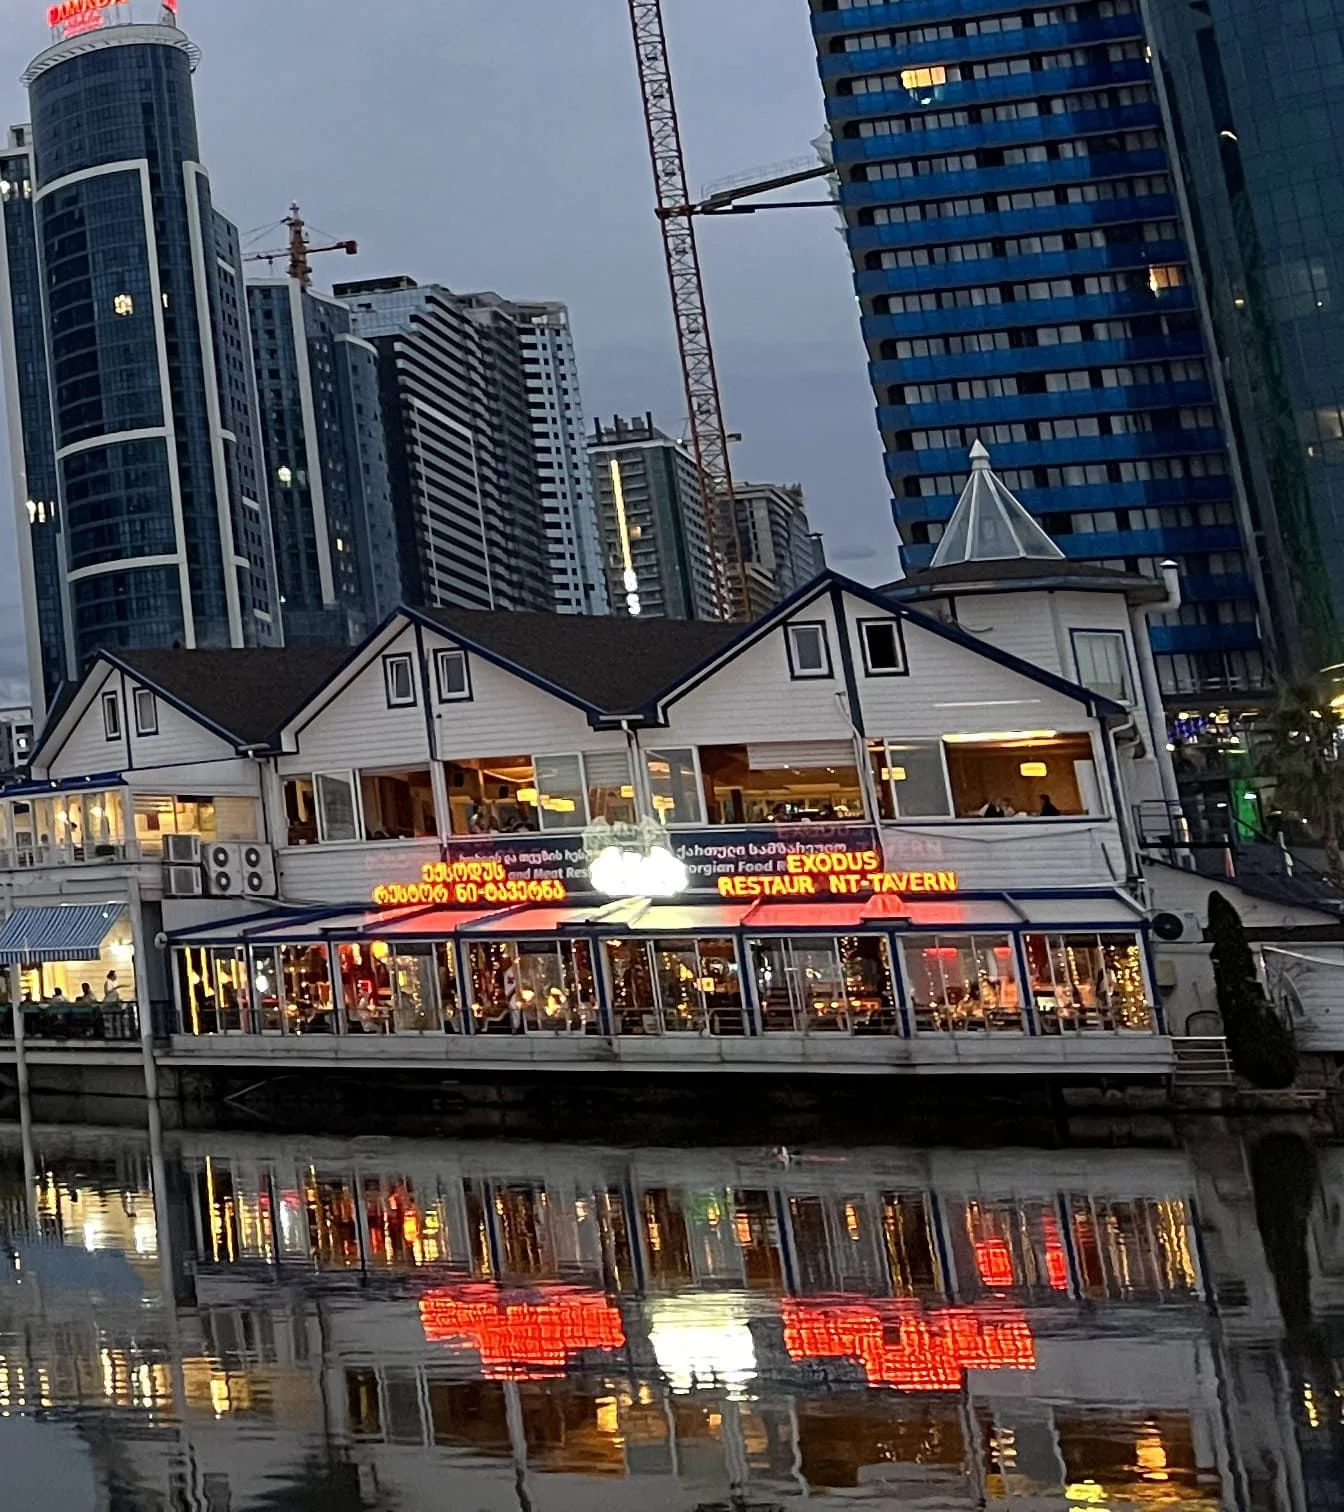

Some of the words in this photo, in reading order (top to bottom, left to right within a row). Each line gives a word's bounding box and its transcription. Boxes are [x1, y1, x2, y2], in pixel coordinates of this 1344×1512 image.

[684, 859, 735, 876] orgian
[738, 860, 773, 873] Food
[786, 851, 878, 873] EXODUS
